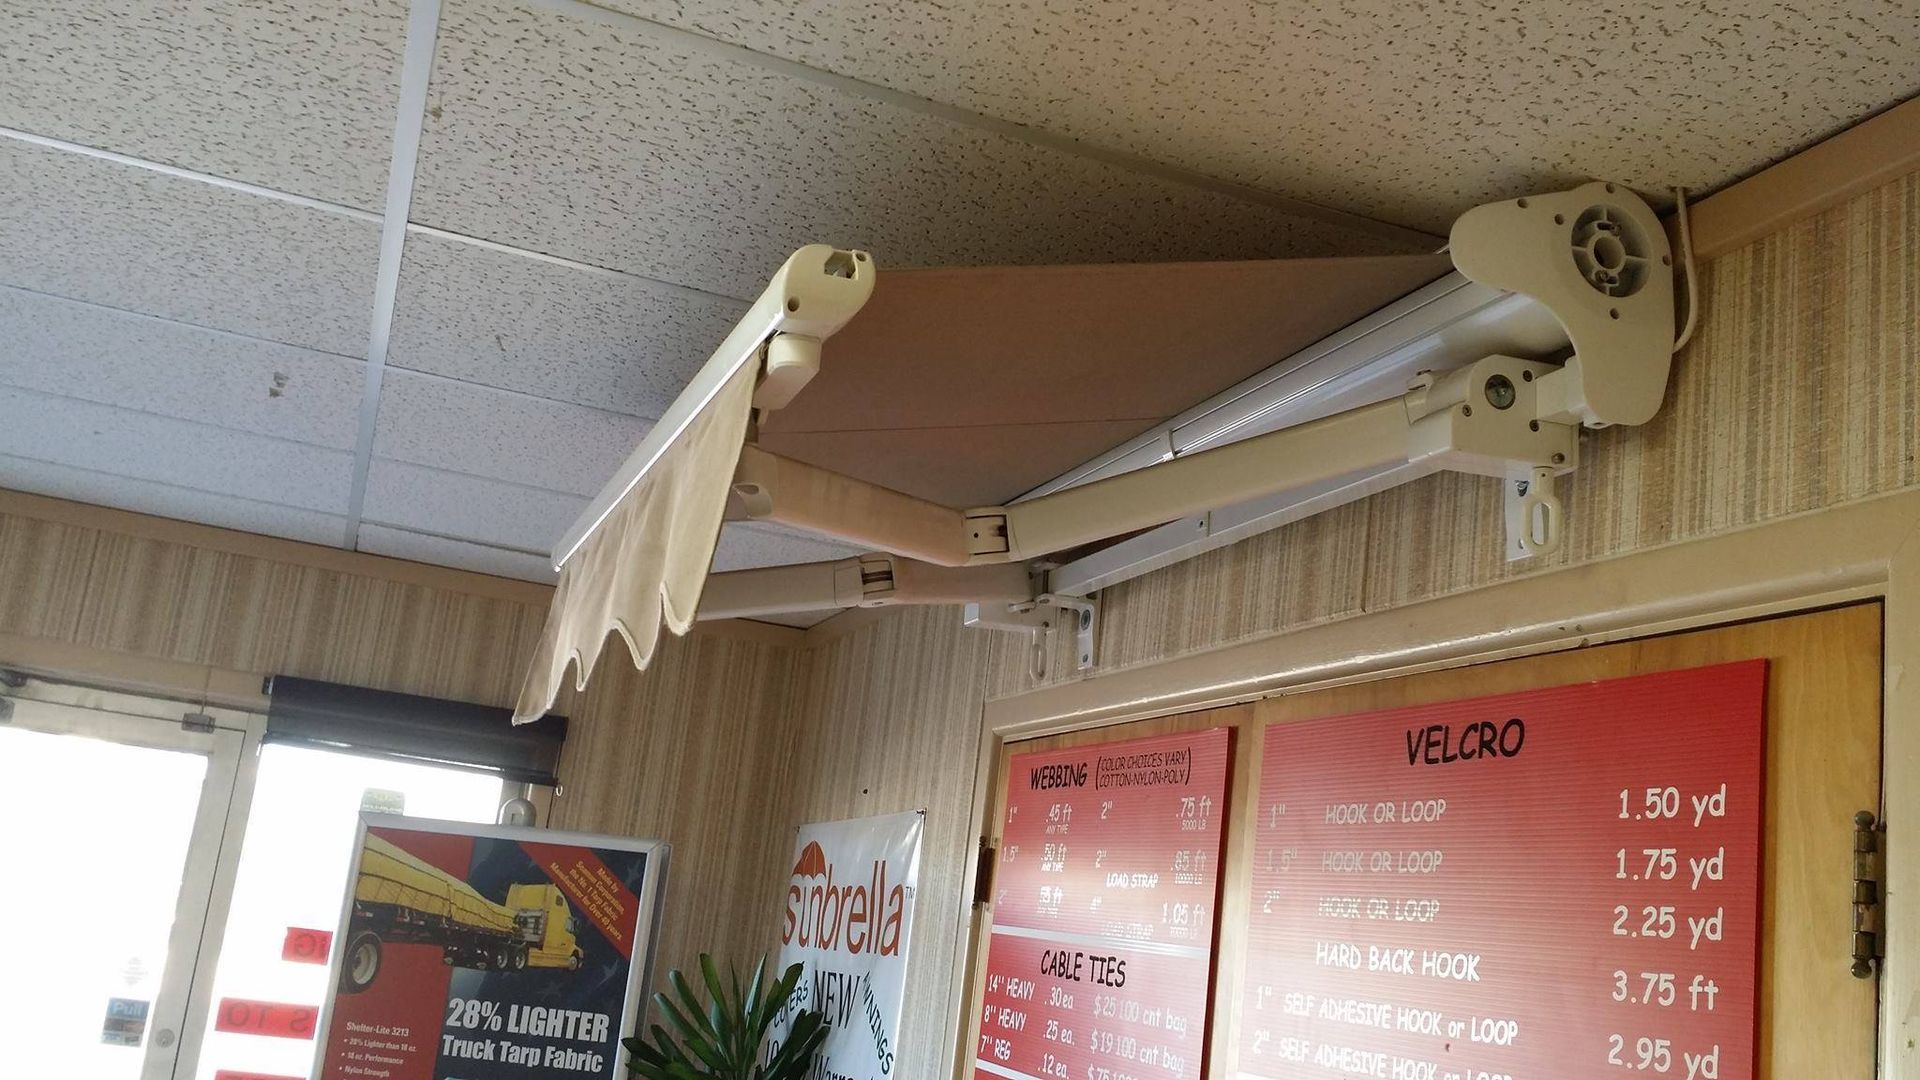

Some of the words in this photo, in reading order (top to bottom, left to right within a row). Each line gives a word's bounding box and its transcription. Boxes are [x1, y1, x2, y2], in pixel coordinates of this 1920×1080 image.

[1406, 718, 1526, 766] VELCRO
[1031, 762, 1088, 790] WEBBING
[1127, 753, 1162, 769] CHOICES
[1164, 750, 1187, 766] VARY
[1045, 804, 1060, 822] .45
[1062, 803, 1073, 823] ft
[1101, 800, 1113, 819] 2"
[1175, 797, 1195, 818] .75
[1199, 795, 1212, 817] ft
[1269, 804, 1286, 829] 1"
[1325, 804, 1368, 825] HOOK
[1373, 802, 1395, 824] OR
[1402, 799, 1446, 824] LOOP
[1618, 786, 1680, 820] 1.50
[1691, 783, 1726, 827] yd
[1106, 872, 1129, 888] LOAD
[1131, 872, 1159, 888] STRAP
[1322, 851, 1364, 873] HOOK
[1370, 851, 1392, 872] OR
[1399, 850, 1443, 873] LOOP
[1615, 848, 1677, 880] 1.75
[1689, 846, 1724, 890] yd
[782, 860, 904, 957] sunbrella
[1162, 902, 1188, 924] 1.05
[1318, 896, 1361, 919] HOOK
[1367, 898, 1389, 920] OR
[1395, 899, 1440, 922] LOOP
[1613, 905, 1676, 939] 2.25
[1688, 906, 1723, 950] yd
[1041, 950, 1083, 981] CABLE
[1089, 955, 1126, 988] TIES
[1316, 941, 1361, 970] HARD
[1369, 946, 1414, 975] BACK
[1422, 950, 1480, 982] HOOK
[811, 969, 861, 1030] NEW
[1006, 977, 1035, 1000] HEAVY
[1166, 1008, 1187, 1040] bag
[1612, 970, 1675, 1006] 3.75
[1688, 975, 1718, 1011] ft
[346, 1021, 390, 1035] Shelter-Lite
[391, 1027, 410, 1037] 3213
[446, 998, 502, 1032] 28%
[507, 1004, 610, 1043] LIGHTER
[1283, 992, 1315, 1017] SELF
[1319, 997, 1392, 1030] ADHESIVE
[1396, 1008, 1442, 1036] HOOK
[1448, 1020, 1465, 1039] or
[1470, 1016, 1518, 1045] LOOP
[386, 1042, 400, 1051] than
[443, 1034, 496, 1061] Truck
[500, 1041, 541, 1068] Tarp
[544, 1046, 603, 1073] Fabric
[994, 1039, 1011, 1060] REG
[998, 1008, 1026, 1031] HEAVY
[1140, 1045, 1158, 1065] cnt
[1163, 1046, 1185, 1078] bag
[1279, 1037, 1310, 1062] SELF
[1314, 1044, 1387, 1078] ADHESIVE
[1392, 1056, 1438, 1080] HOOK
[1608, 1033, 1671, 1072] 2.95
[1684, 1044, 1719, 1080] yd
